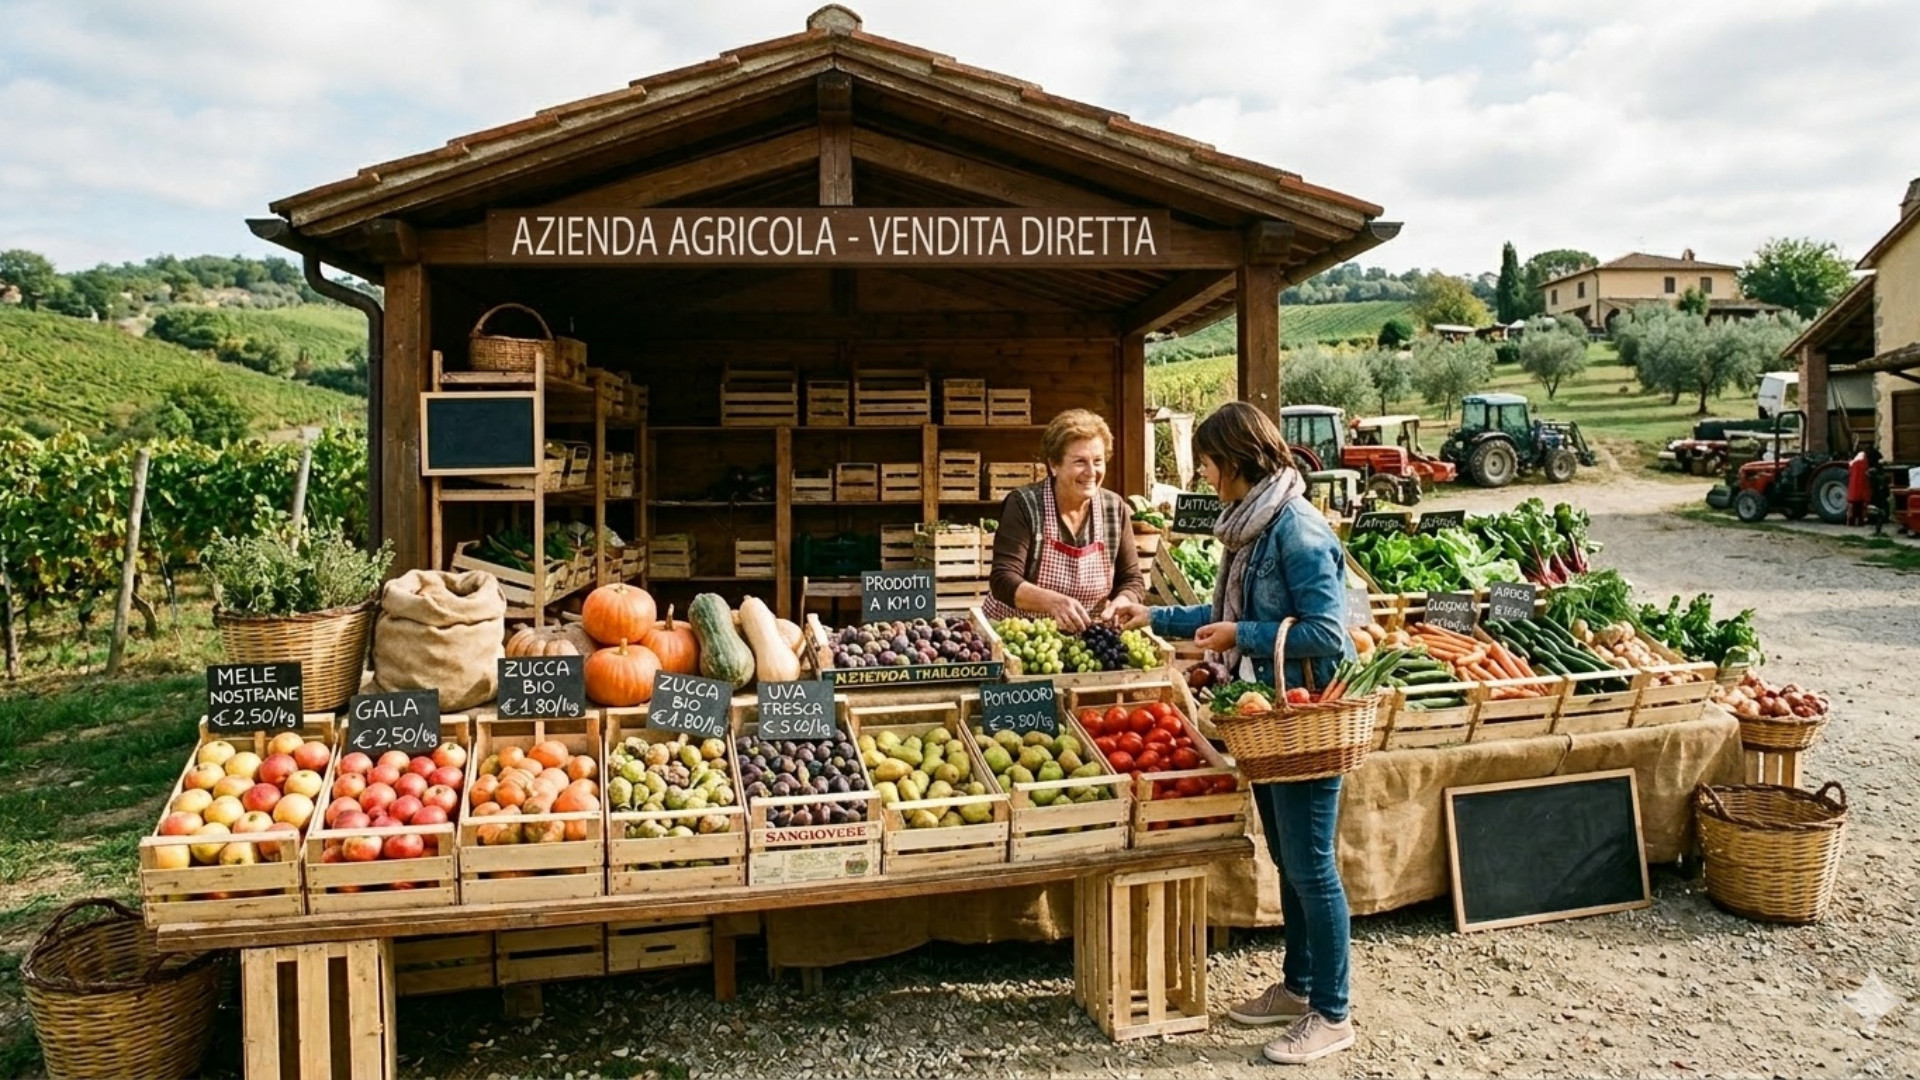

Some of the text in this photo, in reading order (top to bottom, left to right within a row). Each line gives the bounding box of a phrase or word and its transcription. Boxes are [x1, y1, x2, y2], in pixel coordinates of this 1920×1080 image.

[512, 216, 658, 256] AZIENDA
[667, 216, 836, 256] AGRICOLA
[869, 216, 1011, 256] VENDITA
[1021, 216, 1157, 256] DIRETTA
[865, 574, 931, 592] PRODOTTI
[870, 597, 881, 612] A
[217, 666, 277, 686] MELE
[504, 660, 571, 678] ZUCCA
[522, 679, 555, 695] BIO
[658, 674, 719, 701] ZUCCA
[767, 684, 807, 700] UVA
[355, 698, 420, 720] GALA
[671, 695, 701, 711] BIO
